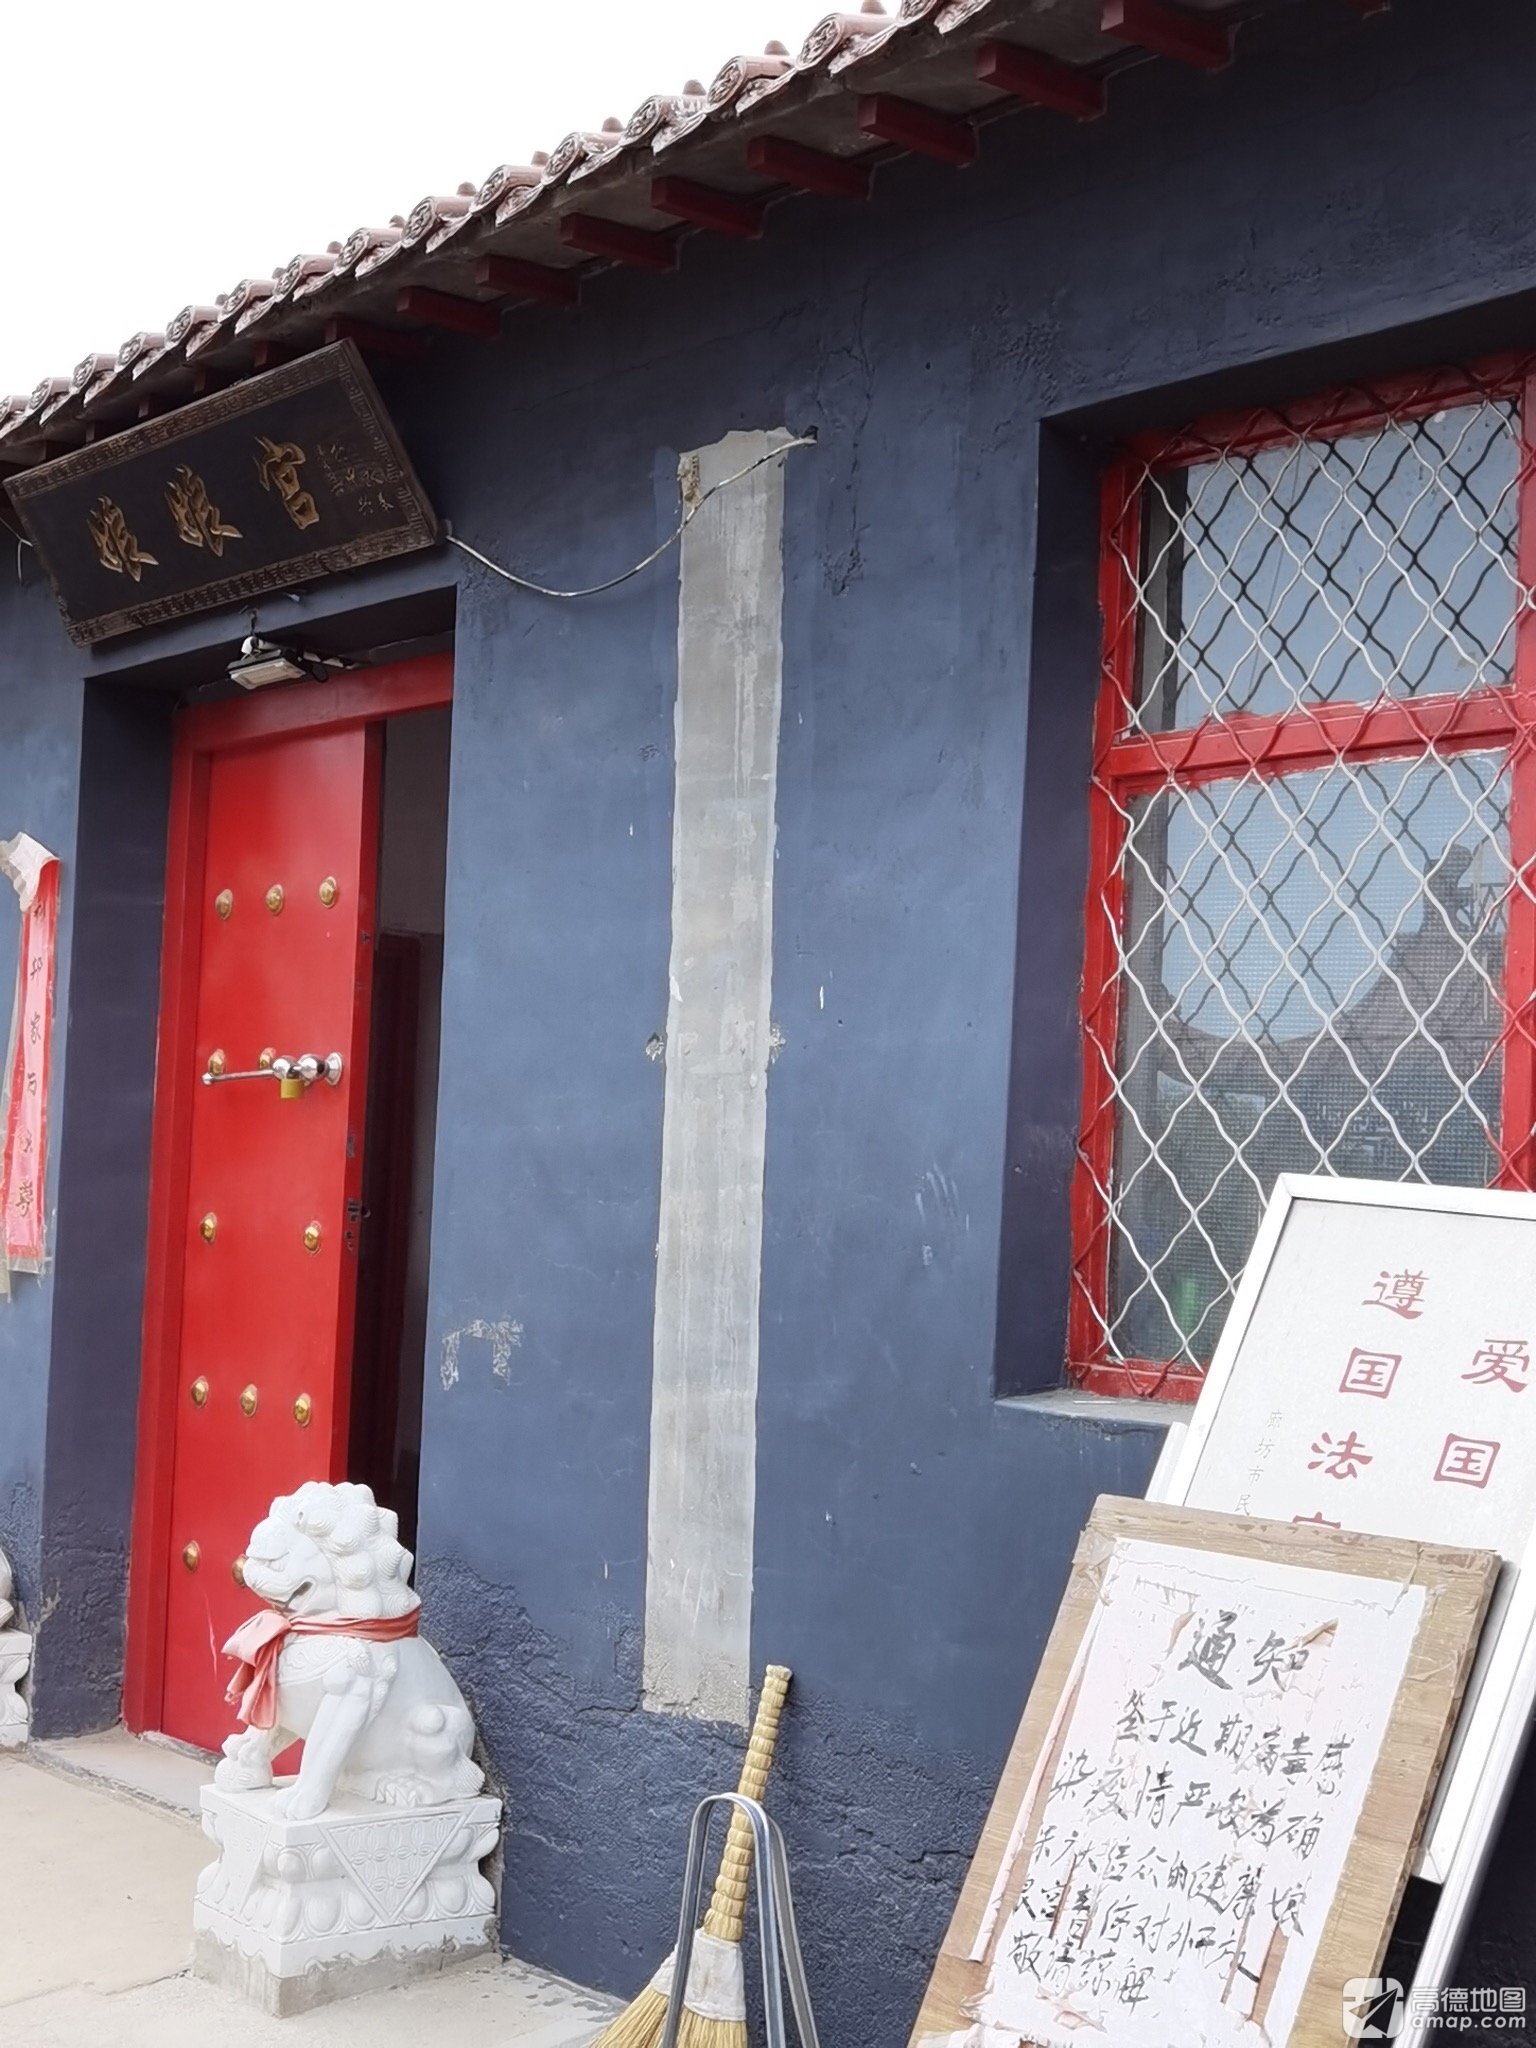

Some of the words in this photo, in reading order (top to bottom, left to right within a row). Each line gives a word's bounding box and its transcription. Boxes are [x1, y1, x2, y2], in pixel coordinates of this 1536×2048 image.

[1292, 1269, 1430, 1528] 遵国法
[1432, 1339, 1530, 1489] 爱国
[1177, 1609, 1310, 1691] 通知
[1008, 1930, 1155, 2014] 敬请谅解
